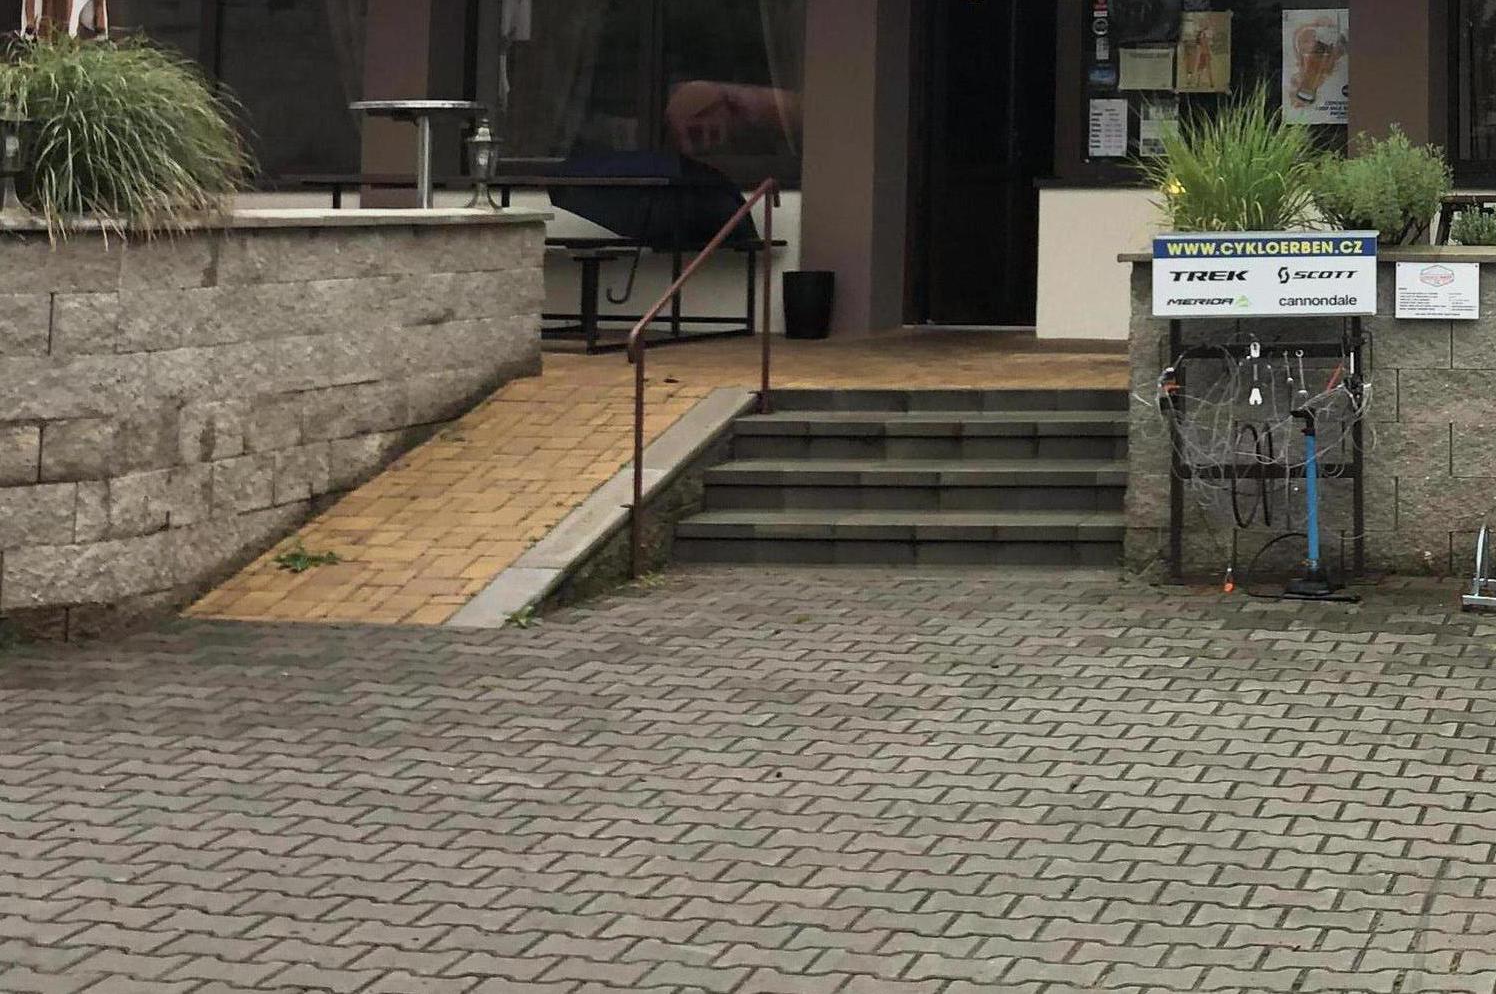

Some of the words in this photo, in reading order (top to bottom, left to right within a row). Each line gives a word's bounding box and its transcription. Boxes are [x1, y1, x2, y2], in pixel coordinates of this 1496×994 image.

[1167, 240, 1363, 256] WWW.CYKLOERBEN.CZ
[1169, 270, 1249, 282] TREK
[1292, 270, 1358, 280] SCOTT
[1166, 297, 1234, 306] MERIDA
[1278, 295, 1358, 307] cannondale
